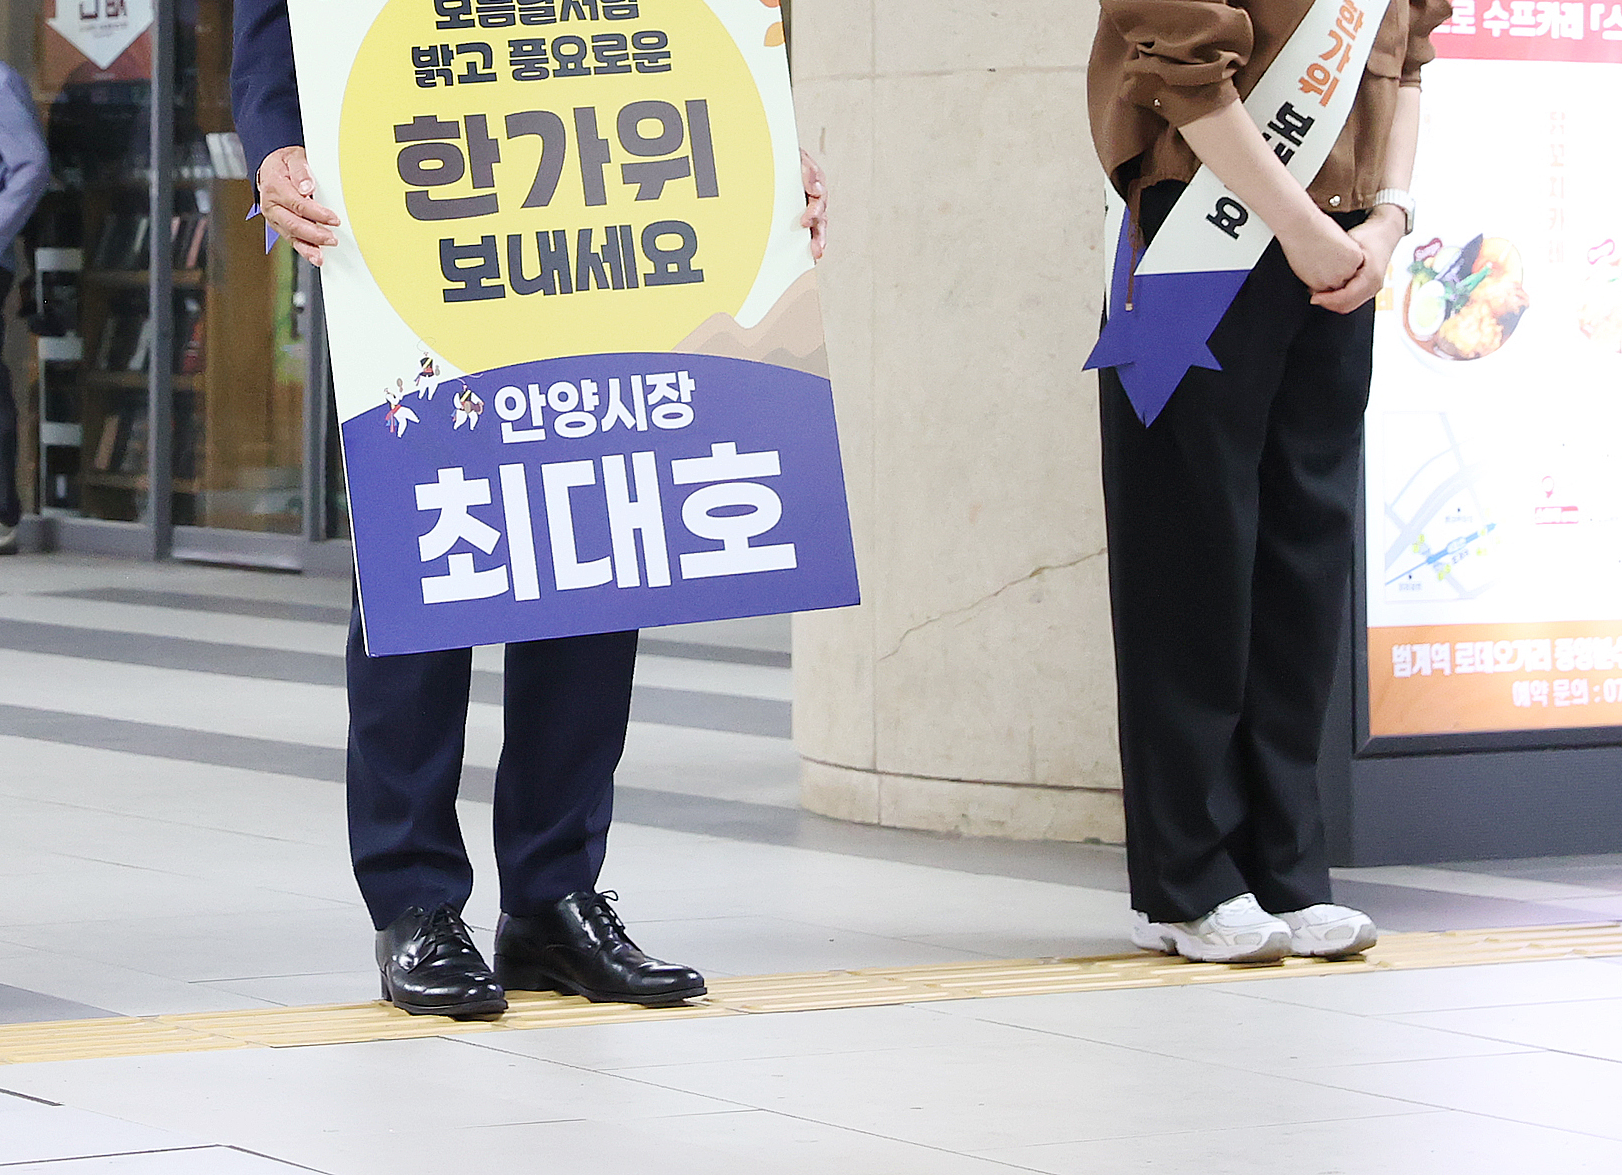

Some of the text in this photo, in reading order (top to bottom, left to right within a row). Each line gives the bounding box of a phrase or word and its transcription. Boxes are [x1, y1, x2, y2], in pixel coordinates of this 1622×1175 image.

[1432, 0, 1476, 34] 로
[1483, 0, 1584, 40] 수프카레
[411, 30, 672, 89] 밝고 풍요로운
[393, 98, 721, 223] 한가위
[438, 219, 705, 304] 보내세요
[494, 370, 696, 444] 안양시장
[413, 441, 798, 605] 최대호
[1392, 643, 1451, 678] 범계역
[1455, 638, 1552, 674] 로데오거리
[1512, 680, 1549, 707] 예약
[1552, 679, 1589, 707] 문의
